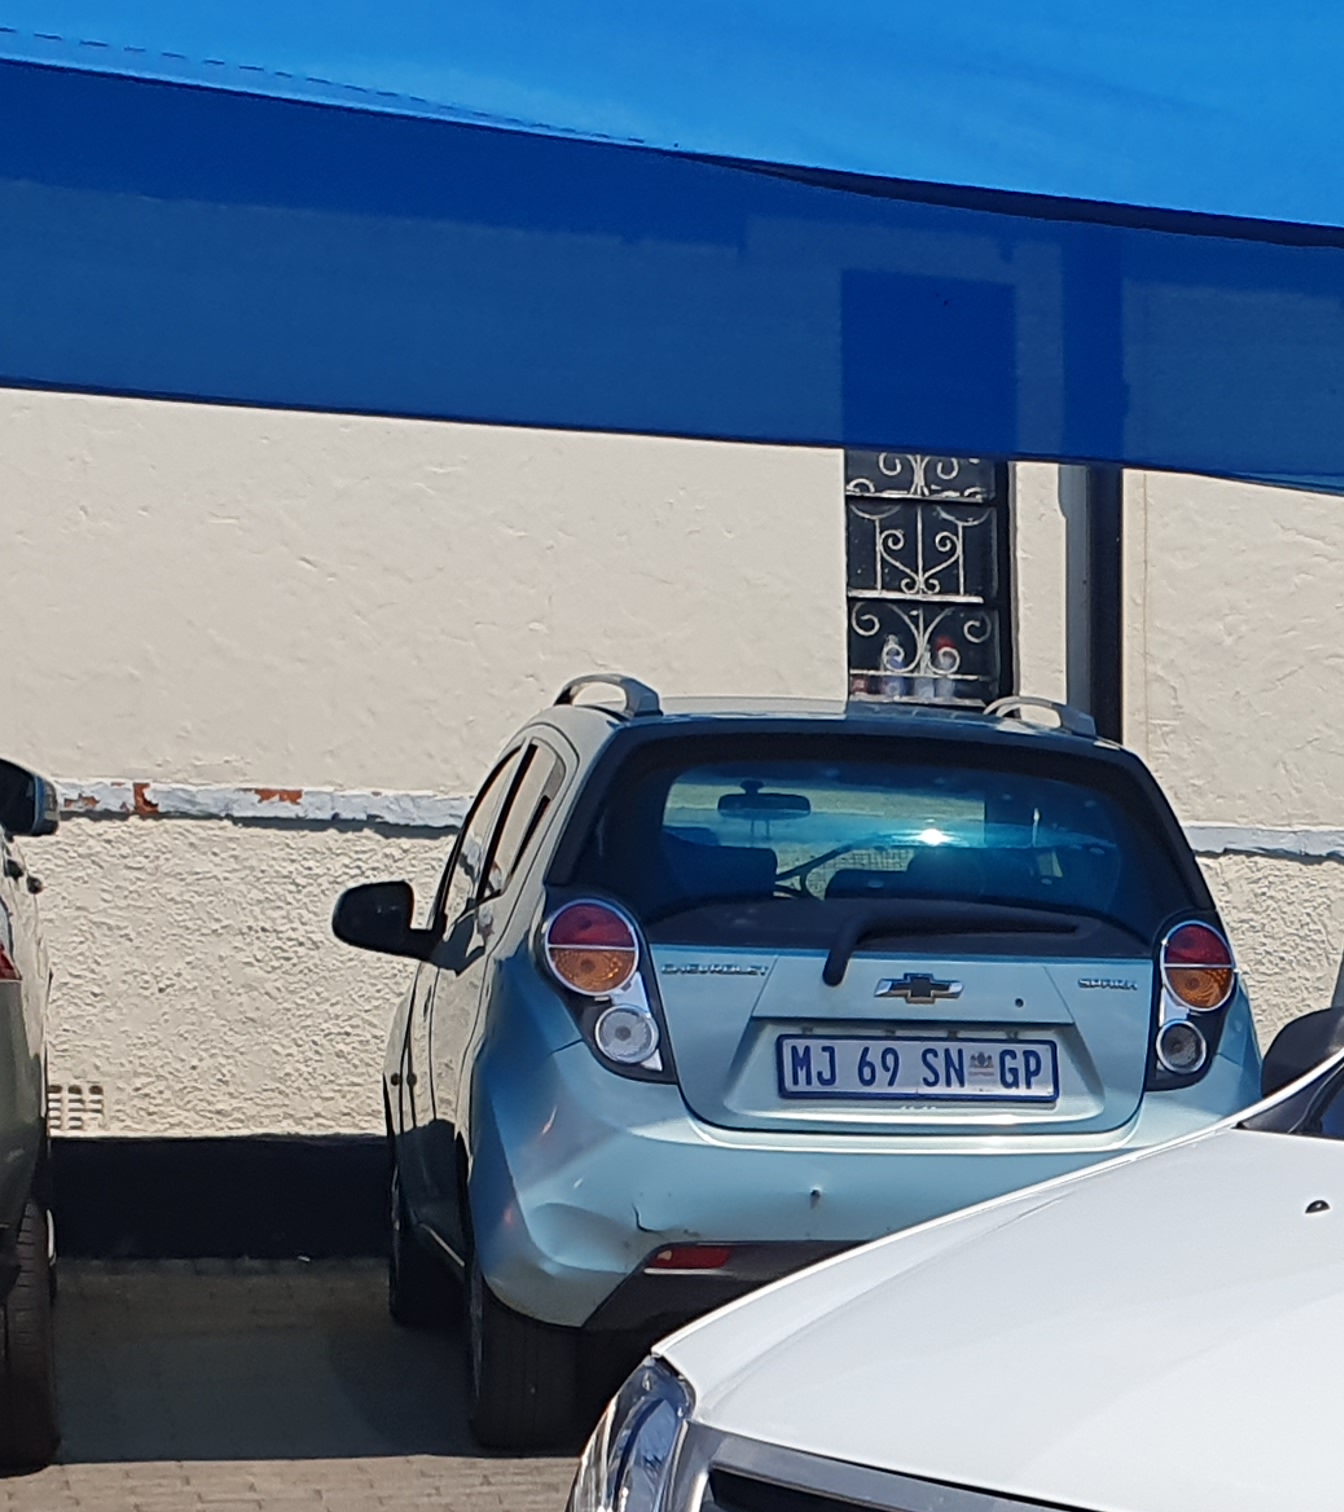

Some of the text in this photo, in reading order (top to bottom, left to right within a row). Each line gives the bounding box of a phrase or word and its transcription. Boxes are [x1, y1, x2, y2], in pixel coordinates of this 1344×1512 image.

[790, 1045, 1042, 1090] MJ 69 SN GP
